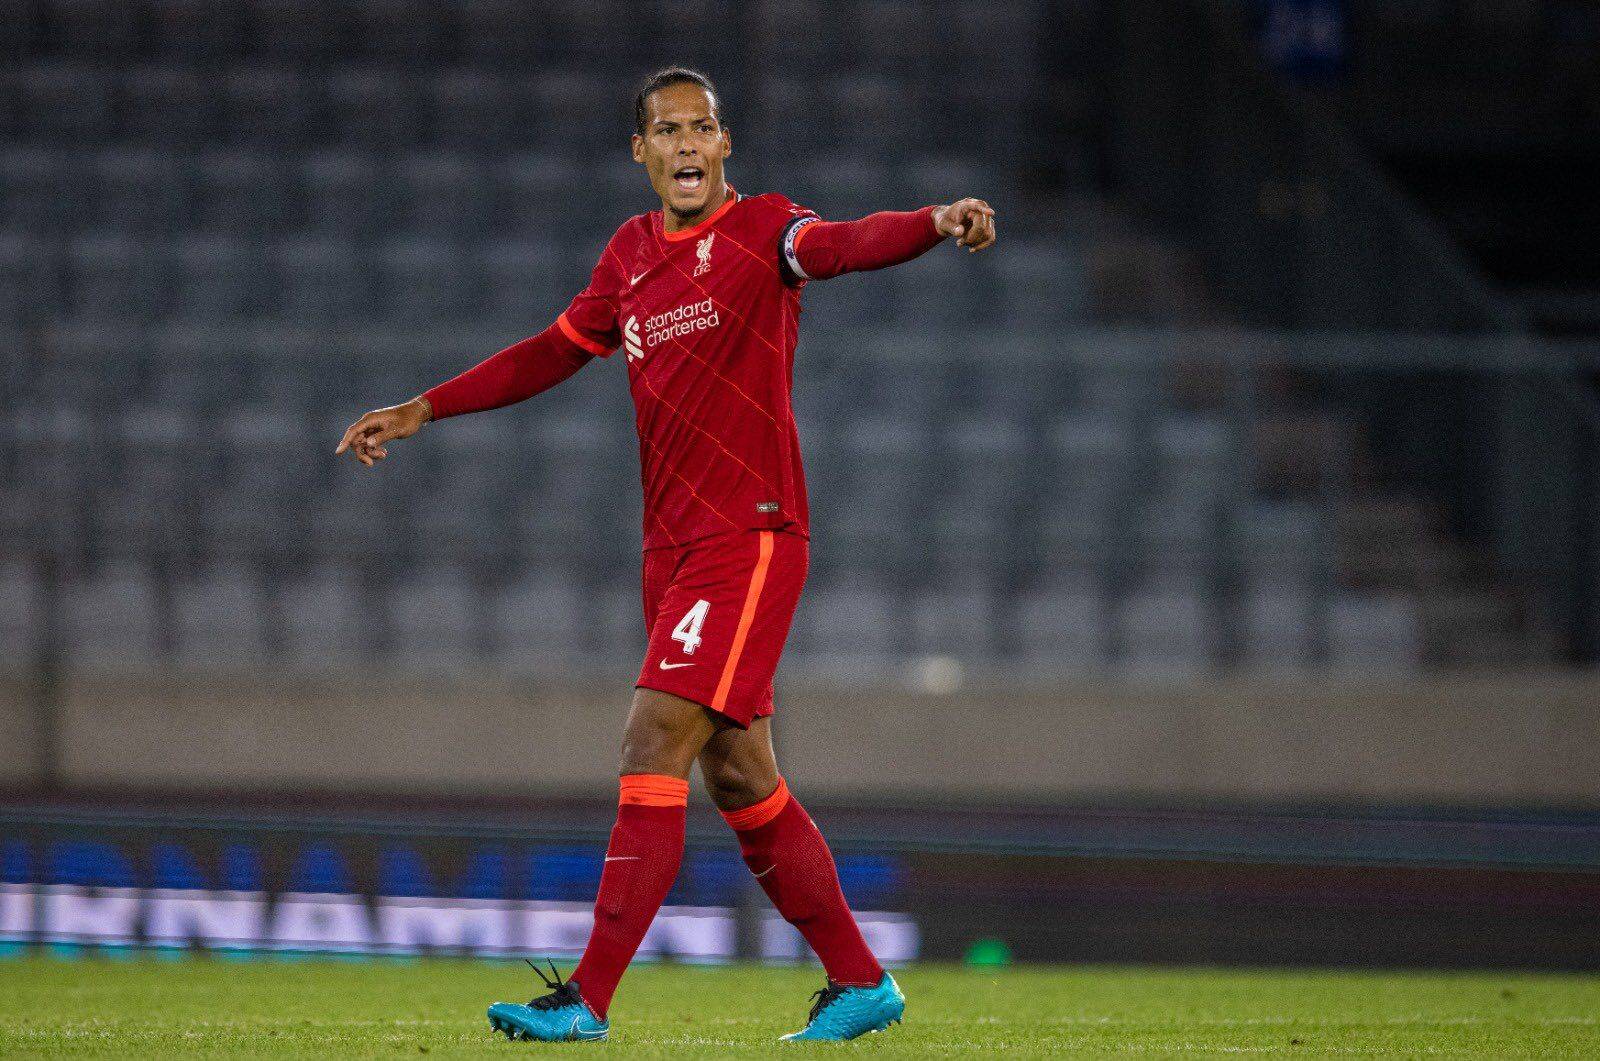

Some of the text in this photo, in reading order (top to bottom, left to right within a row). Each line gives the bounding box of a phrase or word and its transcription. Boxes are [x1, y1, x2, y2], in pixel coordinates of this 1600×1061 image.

[645, 297, 712, 332] standard
[646, 311, 720, 347] chartered
[671, 599, 711, 655] 4
